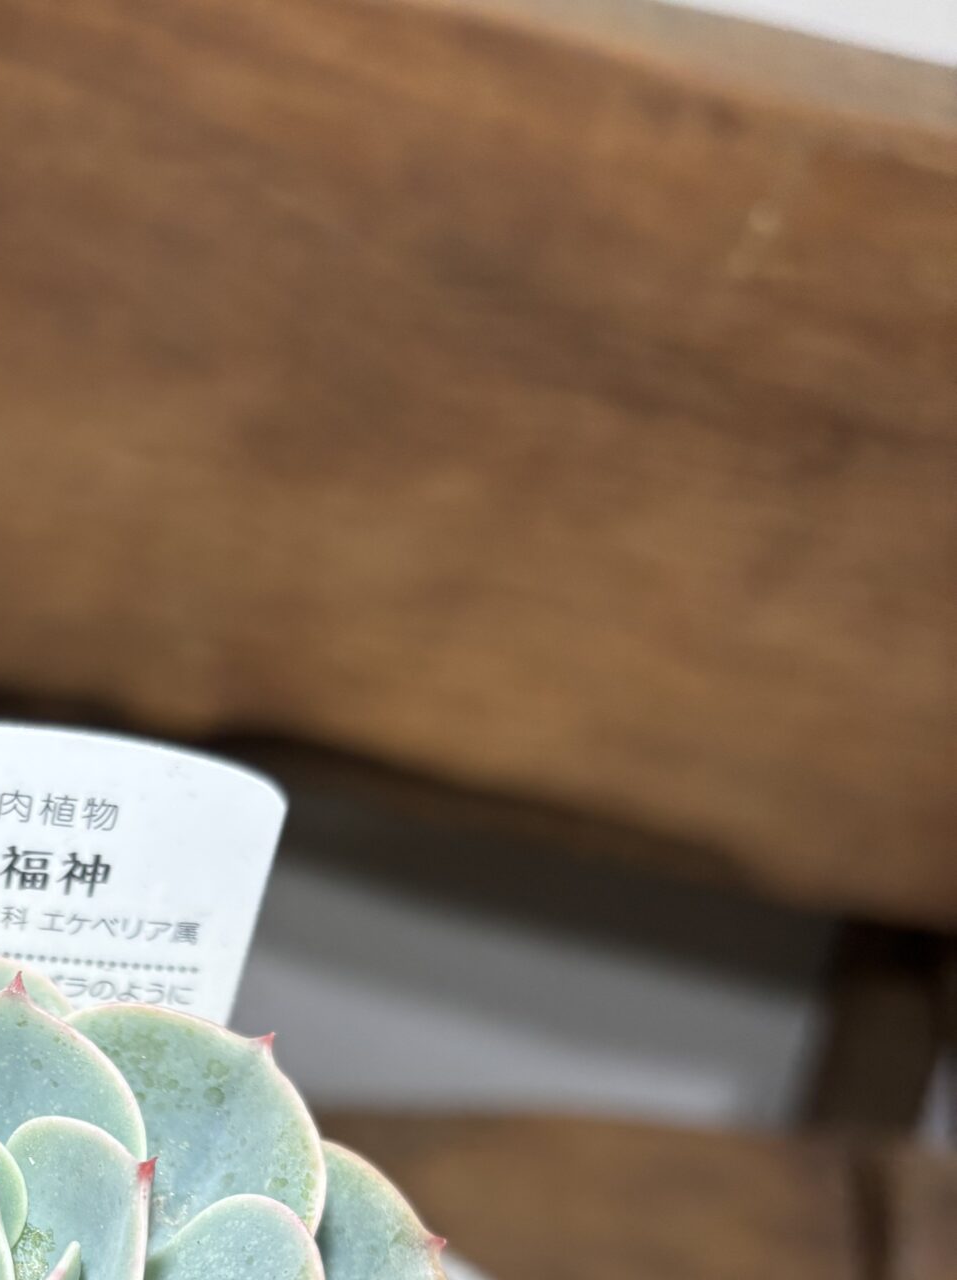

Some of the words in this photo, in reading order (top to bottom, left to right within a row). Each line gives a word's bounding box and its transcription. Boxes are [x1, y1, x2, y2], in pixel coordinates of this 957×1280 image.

[39, 912, 201, 946] エケベリア属
